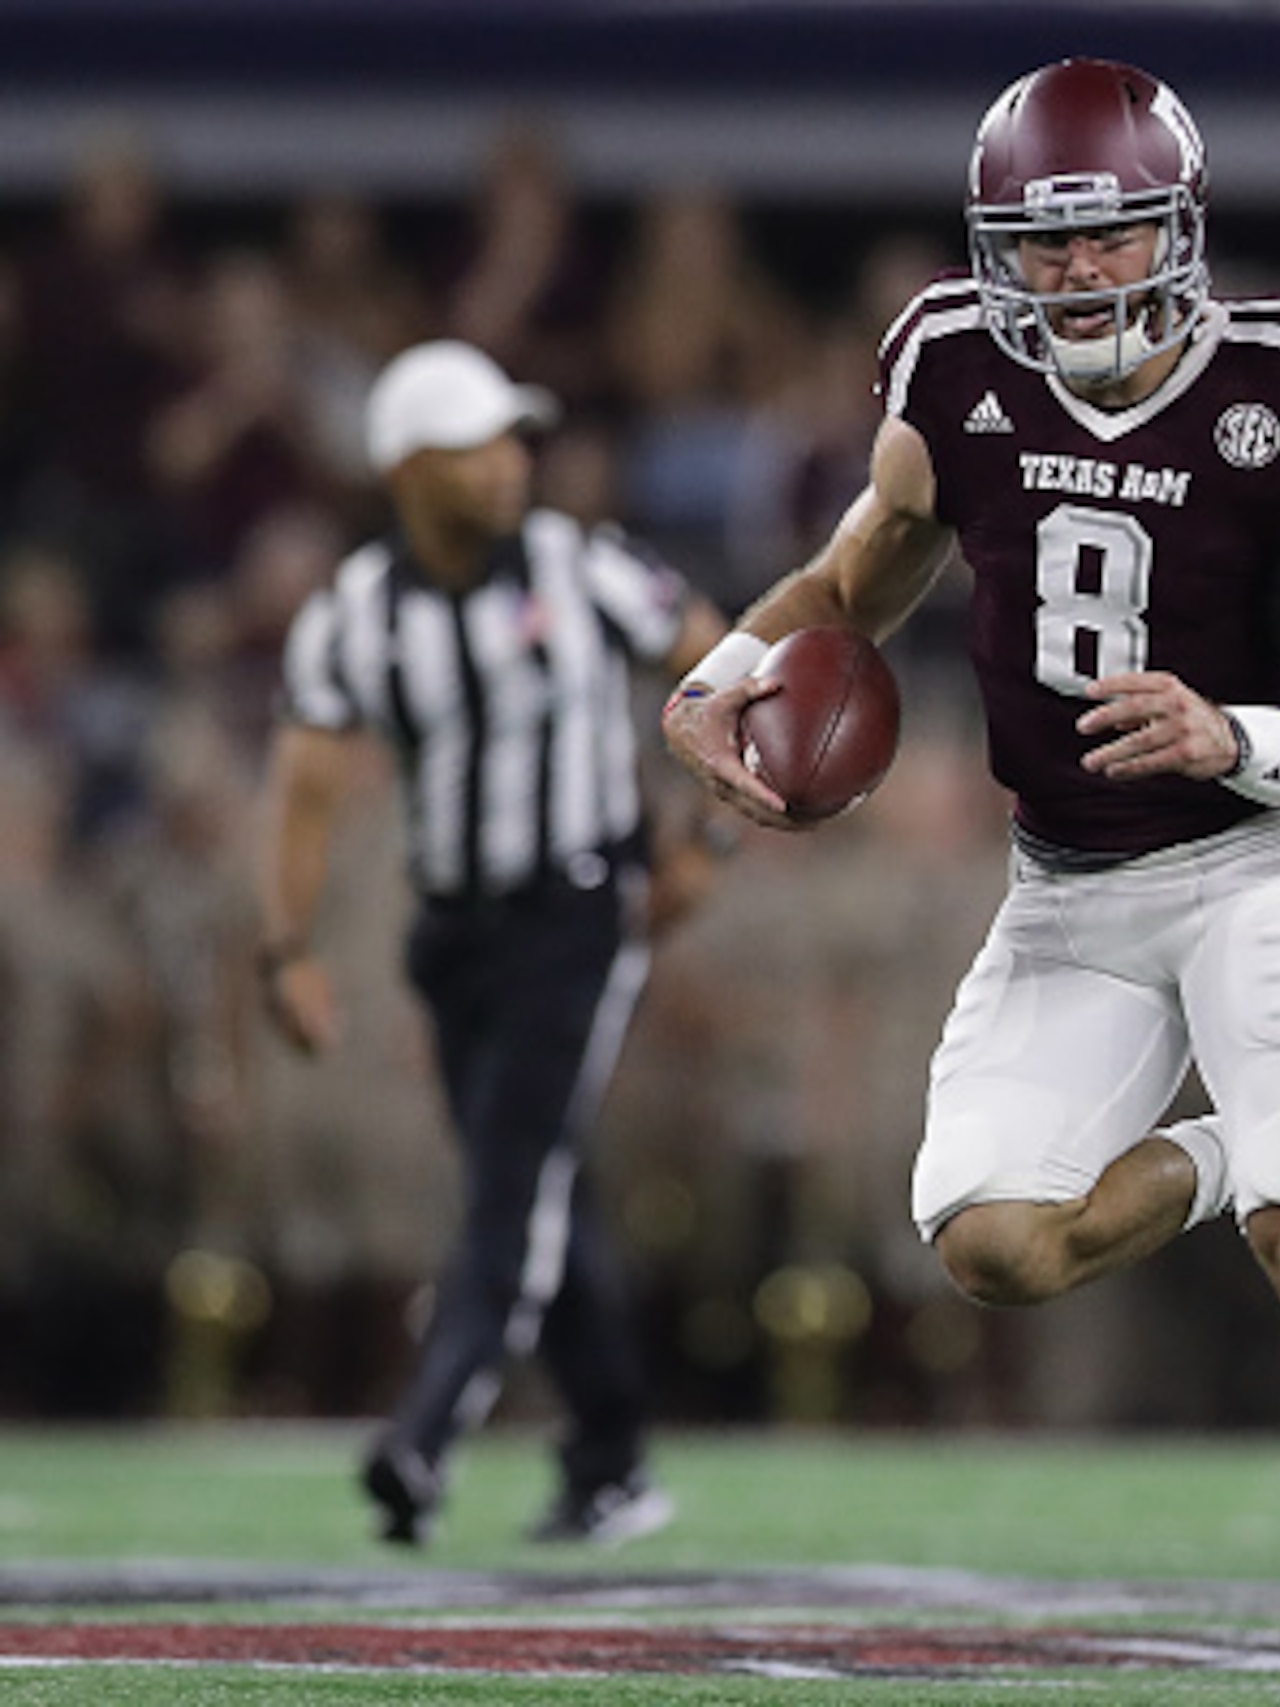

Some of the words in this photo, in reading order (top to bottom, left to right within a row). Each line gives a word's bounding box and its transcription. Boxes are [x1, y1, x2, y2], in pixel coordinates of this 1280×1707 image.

[1226, 408, 1277, 463] SEC
[1019, 452, 1117, 498] TEXAS
[1118, 463, 1192, 506] A&M
[1035, 503, 1153, 698] 8
